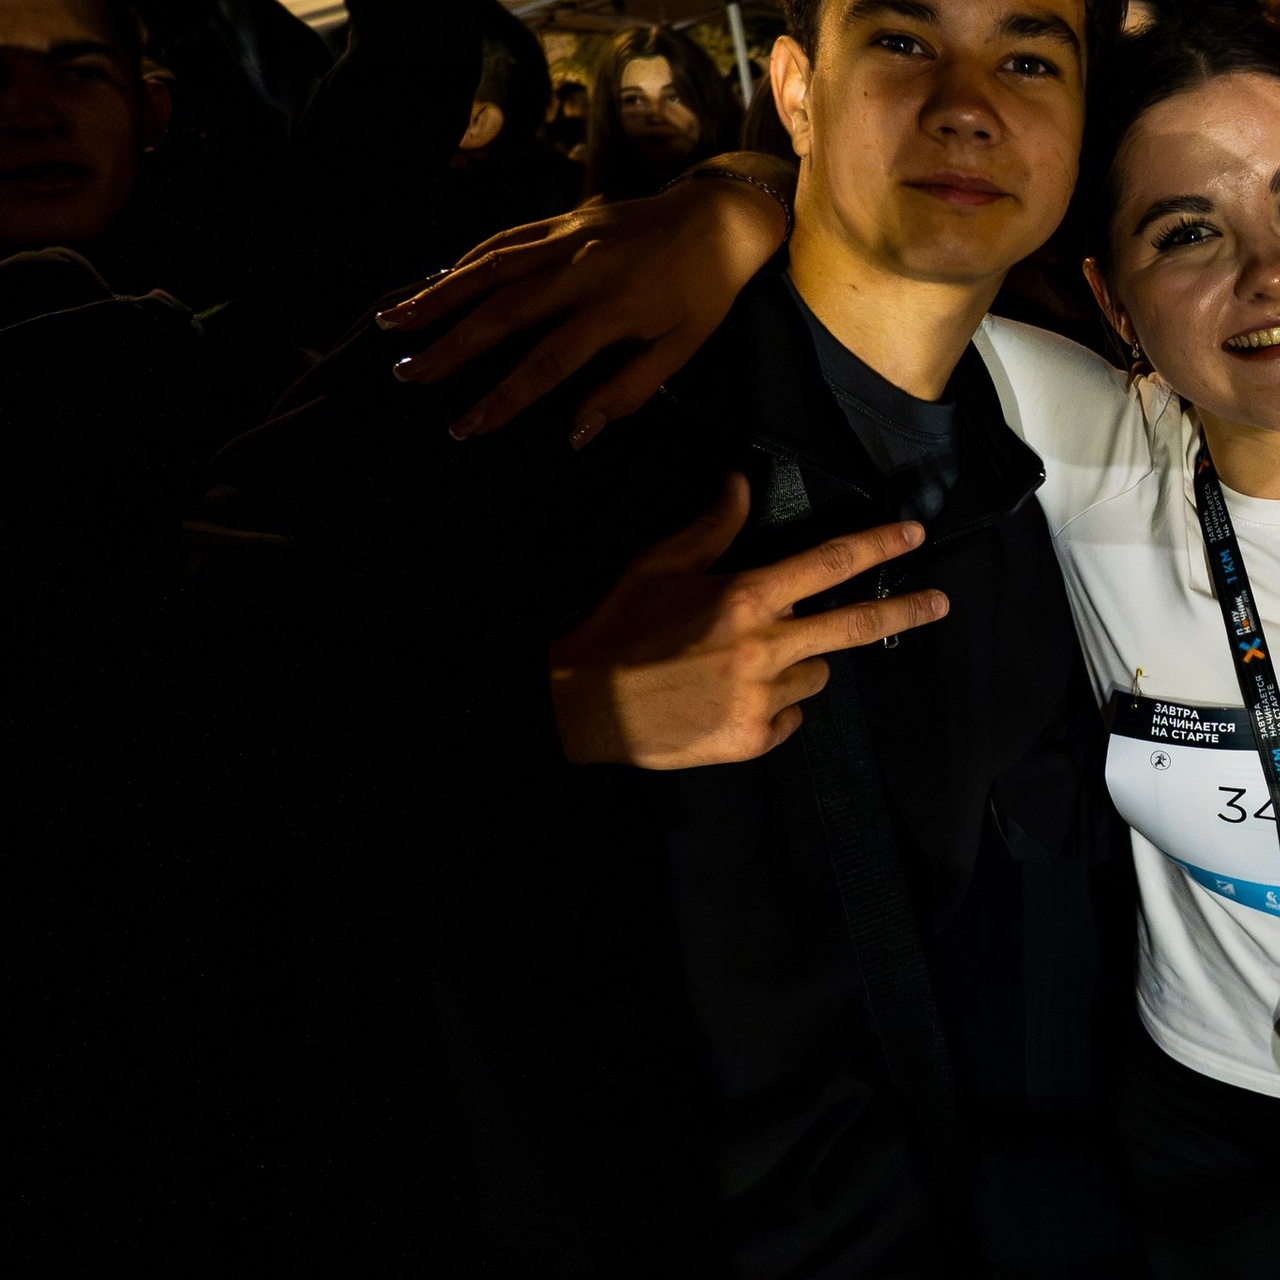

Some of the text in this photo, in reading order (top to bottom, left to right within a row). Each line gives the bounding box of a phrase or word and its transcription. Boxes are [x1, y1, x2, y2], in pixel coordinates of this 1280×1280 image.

[1154, 703, 1199, 720] ЗАВТРА
[1255, 675, 1277, 737] НАЧИНАЕТСЯ
[1152, 714, 1235, 732] НАЧИНАЕТСЯ
[1254, 703, 1265, 740] ЗАВТРА
[1151, 726, 1219, 743] НА СТАРТЕ
